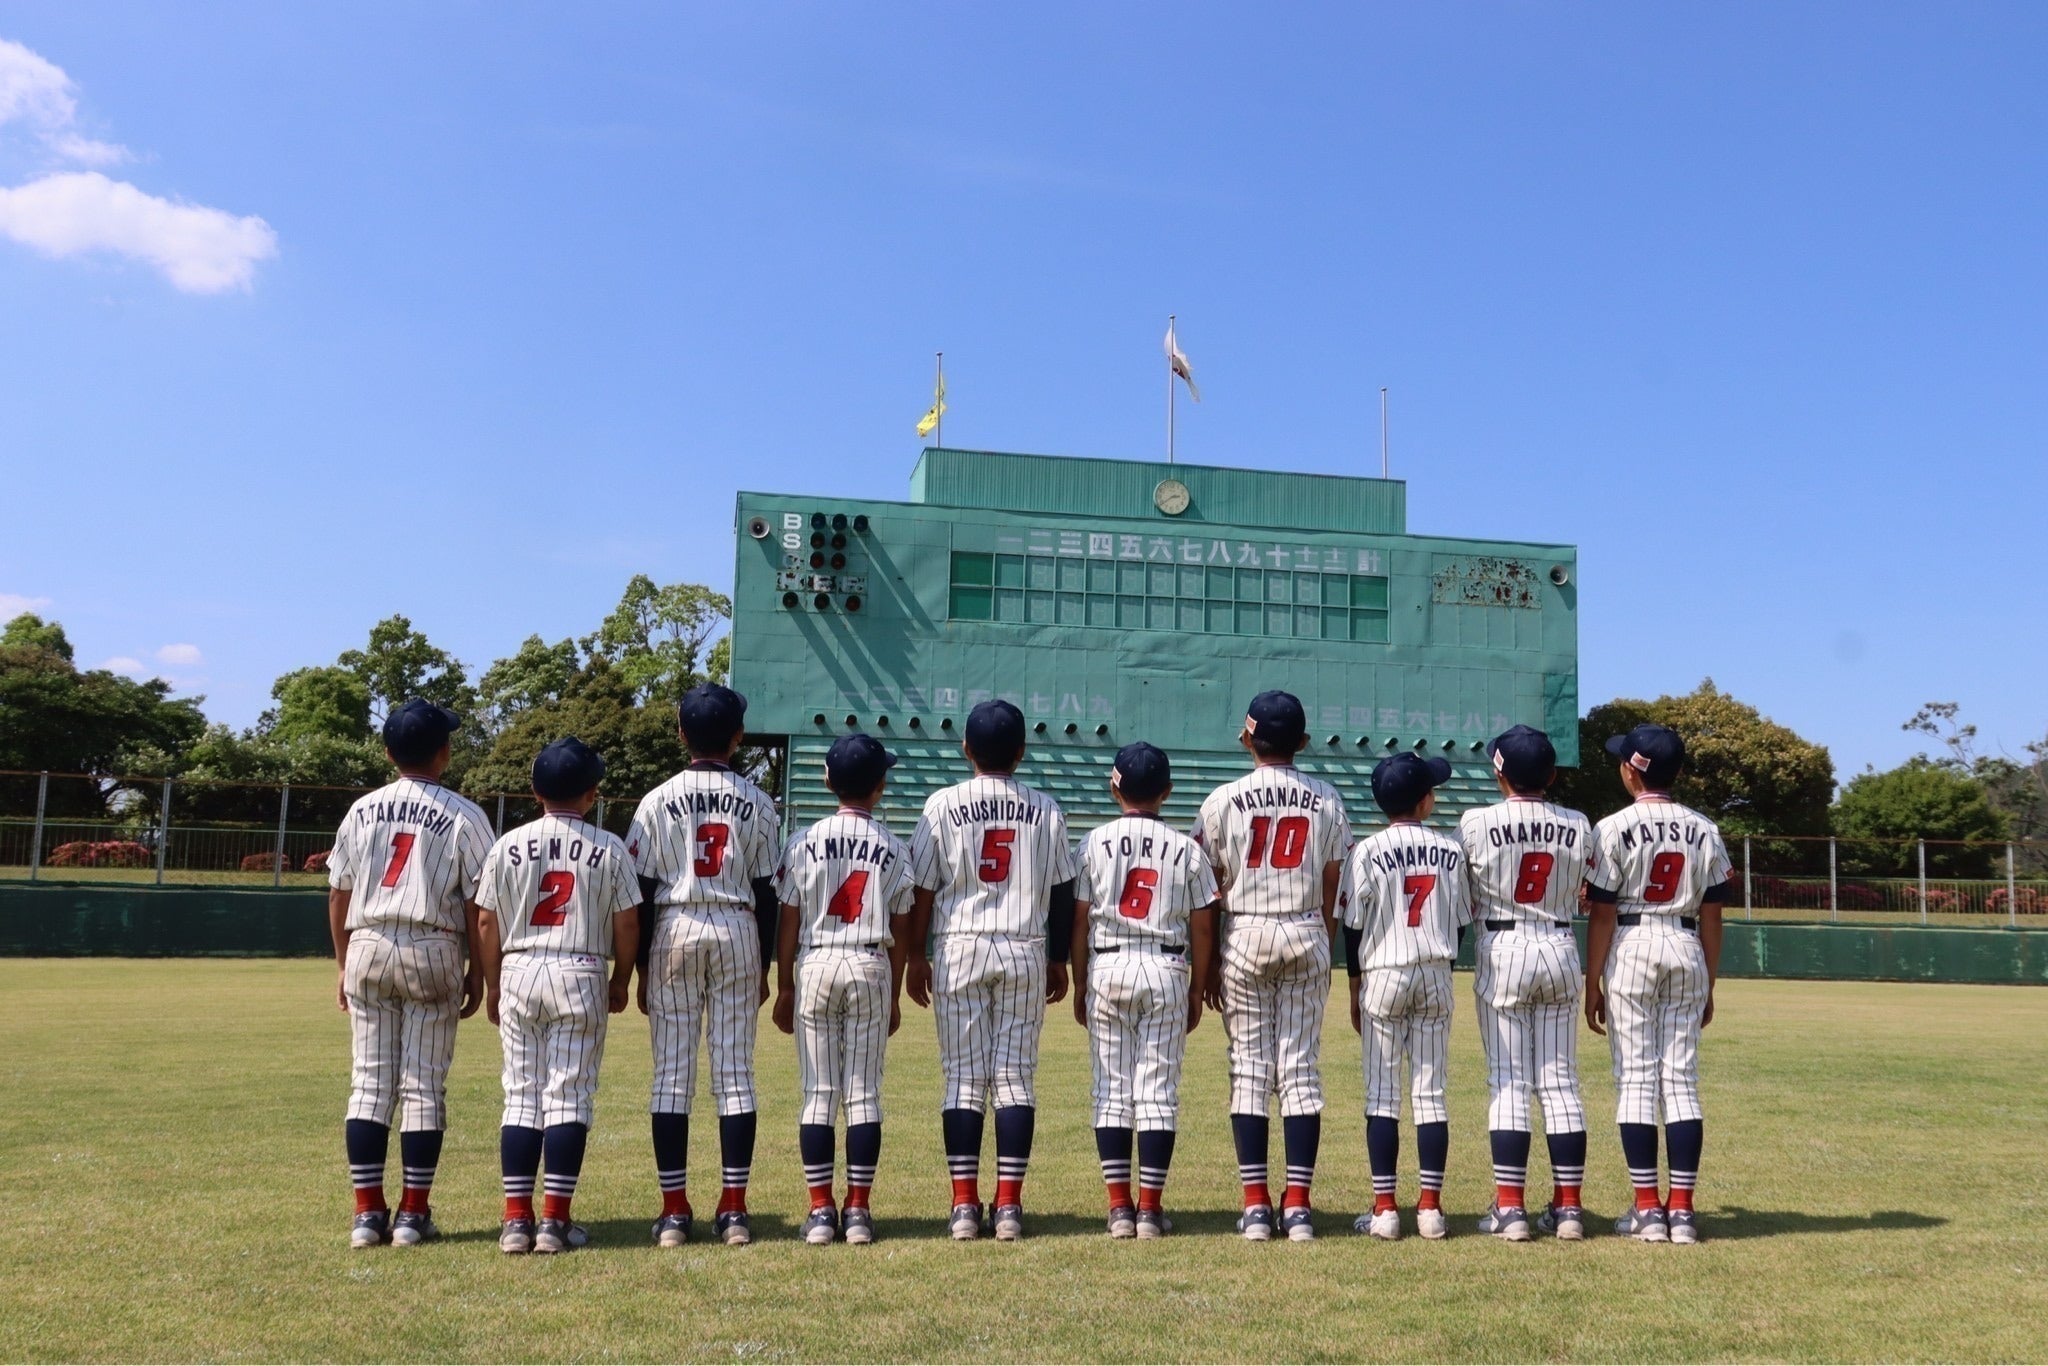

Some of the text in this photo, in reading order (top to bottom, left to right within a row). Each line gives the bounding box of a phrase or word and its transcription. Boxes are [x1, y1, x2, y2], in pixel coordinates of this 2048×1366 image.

[783, 513, 802, 530] B
[782, 533, 801, 549] S
[356, 800, 453, 837] T.TAKAHASHI
[665, 792, 754, 822] MIYAMOTO
[949, 799, 1042, 827] URUSHIDANI
[1231, 787, 1323, 814] WATANABE
[508, 837, 606, 868] SENOH
[694, 823, 729, 877] 3
[1101, 835, 1185, 866] TORII
[1246, 816, 1310, 869] 10
[1489, 822, 1577, 848] OKAMOTO
[1621, 821, 1706, 850] MATSUI
[380, 832, 416, 888] 1
[806, 836, 896, 873] Y.MIYAKE
[978, 828, 1016, 882] 5
[1372, 844, 1459, 875] YAMAMOTO
[1118, 867, 1159, 920] 6
[1514, 851, 1554, 904] 8
[1643, 851, 1685, 903] 9
[529, 870, 575, 926] 2
[826, 870, 870, 924] 4
[1403, 874, 1437, 927] 7
